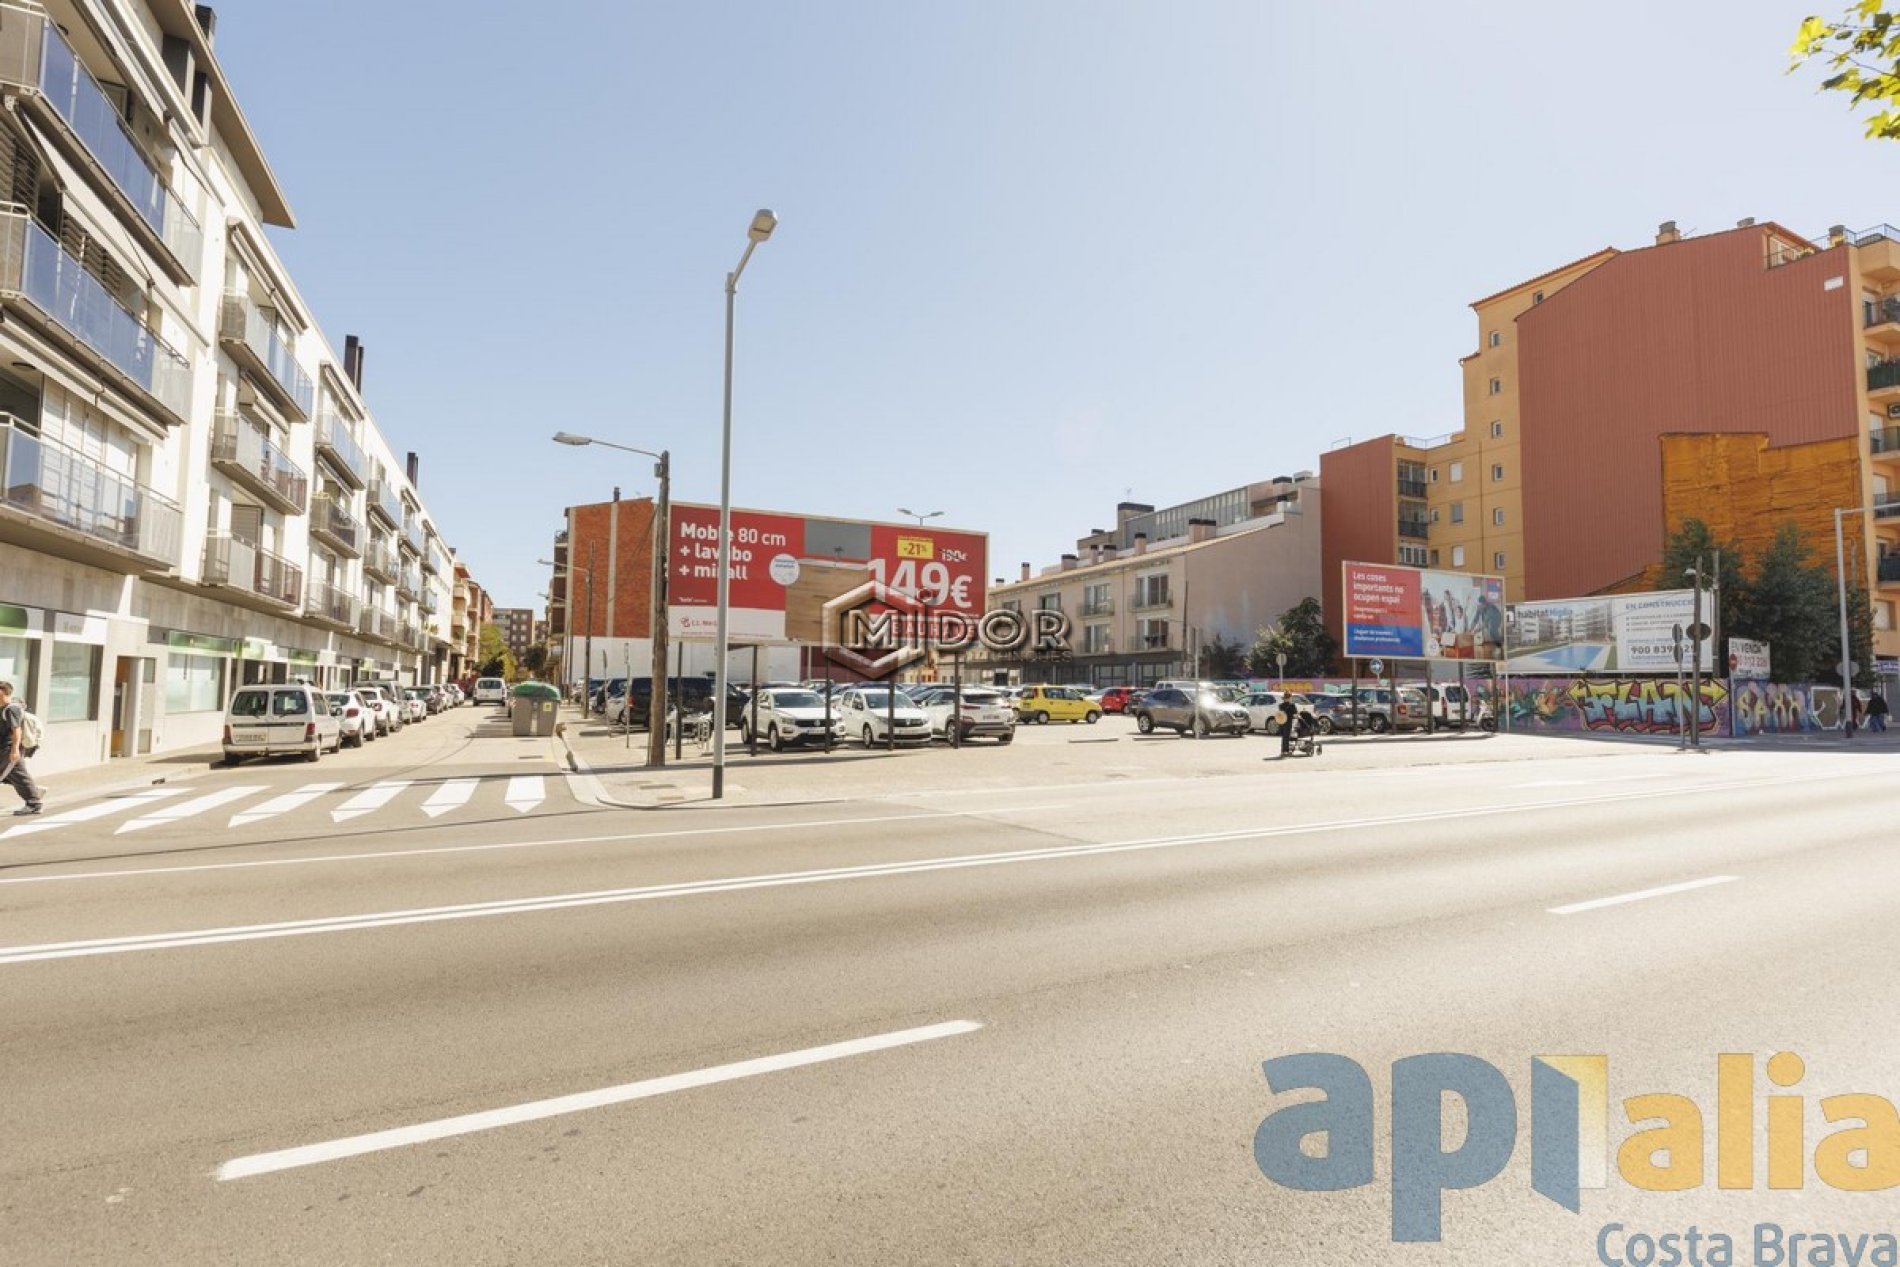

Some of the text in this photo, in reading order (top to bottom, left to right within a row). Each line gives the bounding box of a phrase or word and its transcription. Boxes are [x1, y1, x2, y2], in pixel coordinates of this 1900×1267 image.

[738, 527, 758, 543] 80
[761, 533, 786, 546] cm
[680, 543, 752, 562] + lavbo
[679, 563, 747, 580] + miall
[867, 558, 973, 609] 149€
